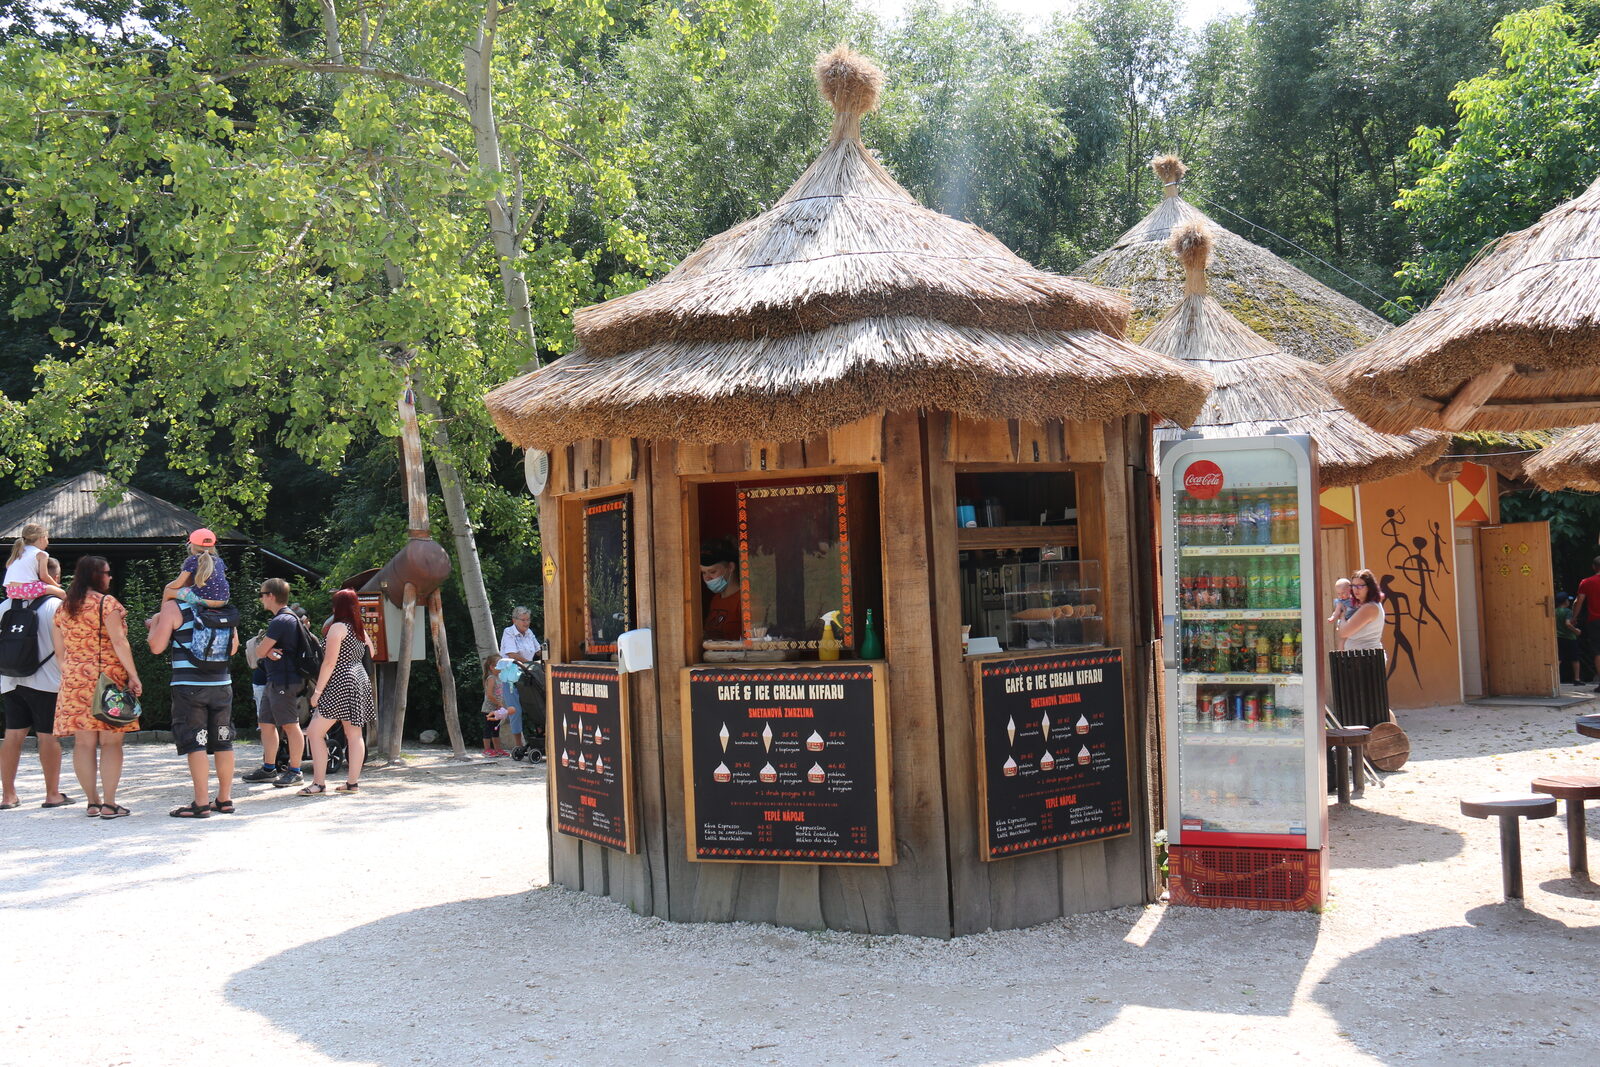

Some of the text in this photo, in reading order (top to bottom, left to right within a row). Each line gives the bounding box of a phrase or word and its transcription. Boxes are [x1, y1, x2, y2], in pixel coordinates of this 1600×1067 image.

[1186, 473, 1221, 486] Coca-Cola
[1006, 669, 1102, 693] CAFÉ & ICE CREAM KIFARU
[718, 683, 844, 700] CAFÉ & ICE CREAM KIFARU
[748, 706, 814, 718] SMETANOVÁ ZMRZLINA
[764, 810, 805, 821] TEPLÉ NÁPOJE
